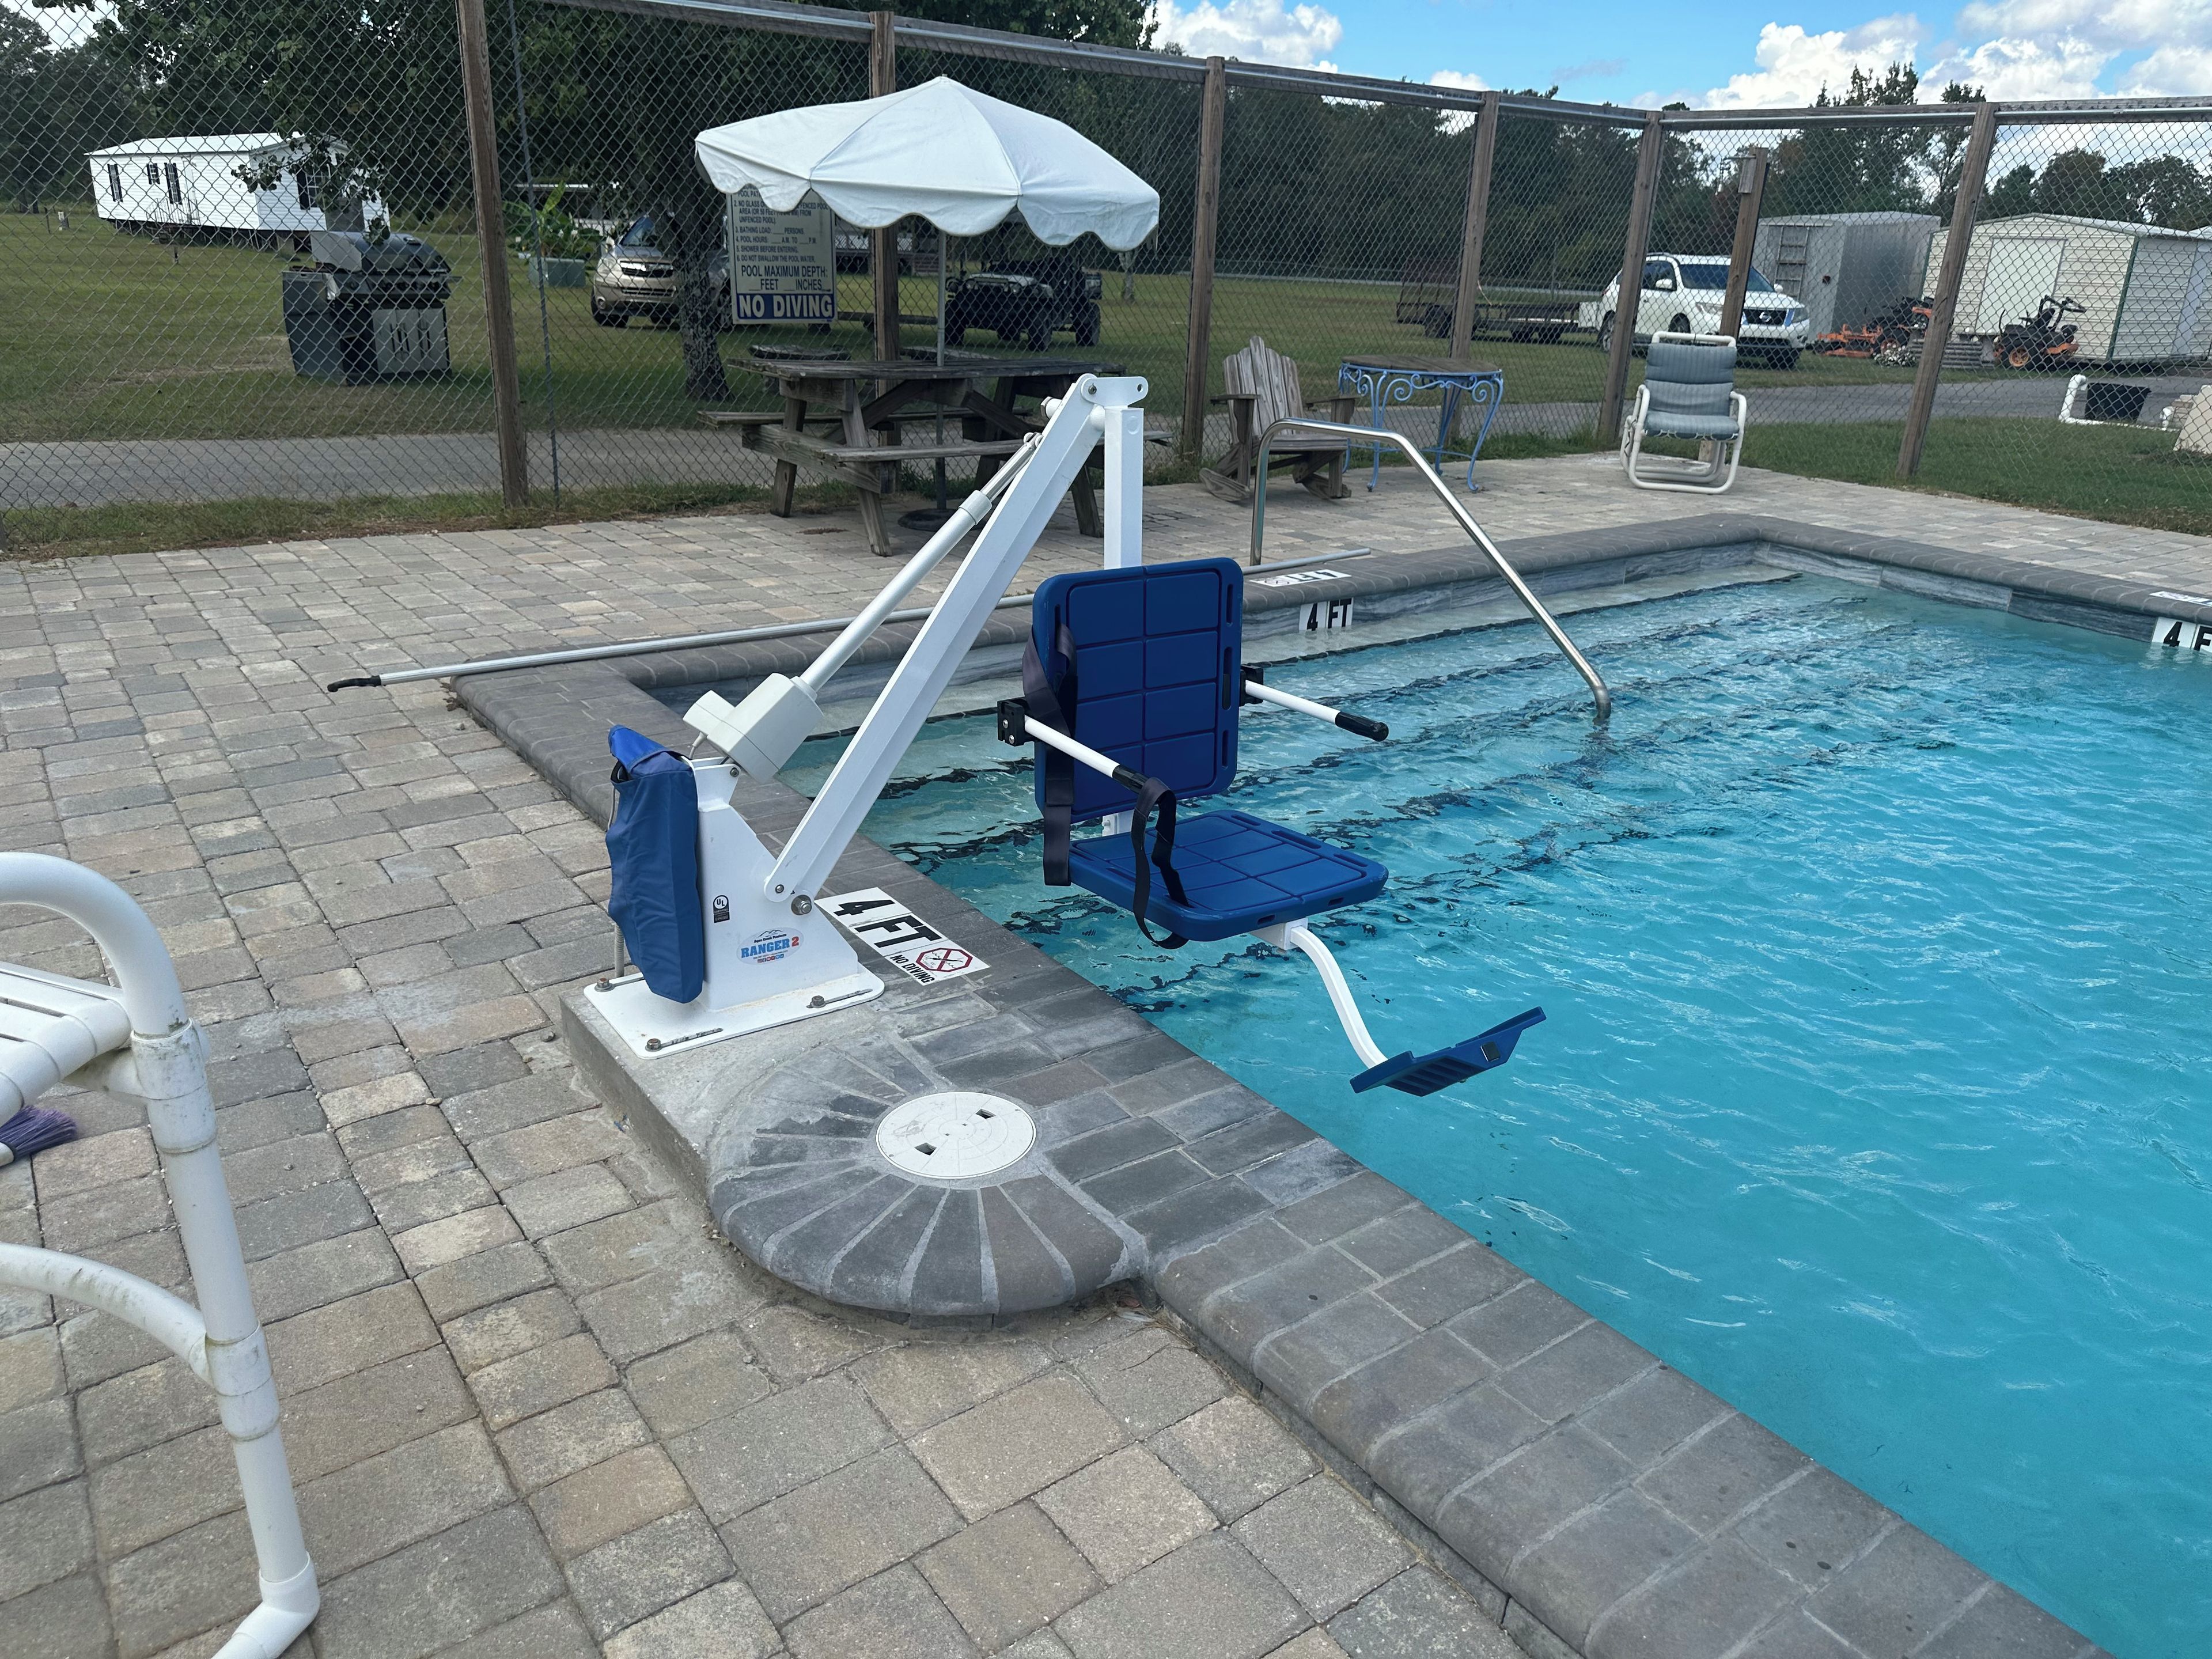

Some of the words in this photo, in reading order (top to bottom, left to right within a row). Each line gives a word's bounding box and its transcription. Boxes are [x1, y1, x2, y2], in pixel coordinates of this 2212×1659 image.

[741, 265, 762, 276] POOL
[764, 266, 800, 277] MAXIMUM
[802, 266, 828, 278] DEPTH:
[760, 279, 779, 290] FEET
[796, 279, 823, 290] INCHES
[738, 294, 765, 318] NO
[772, 294, 832, 317] DIVING
[1306, 603, 1318, 631] 4
[1328, 598, 1352, 629] FT
[2163, 621, 2183, 647] 4
[717, 898, 725, 907] UL
[833, 900, 896, 916] 4
[854, 915, 942, 948] FT
[741, 938, 790, 959] RANGER
[791, 936, 800, 947] 2
[889, 954, 909, 964] NO
[902, 963, 935, 983] DIVING
